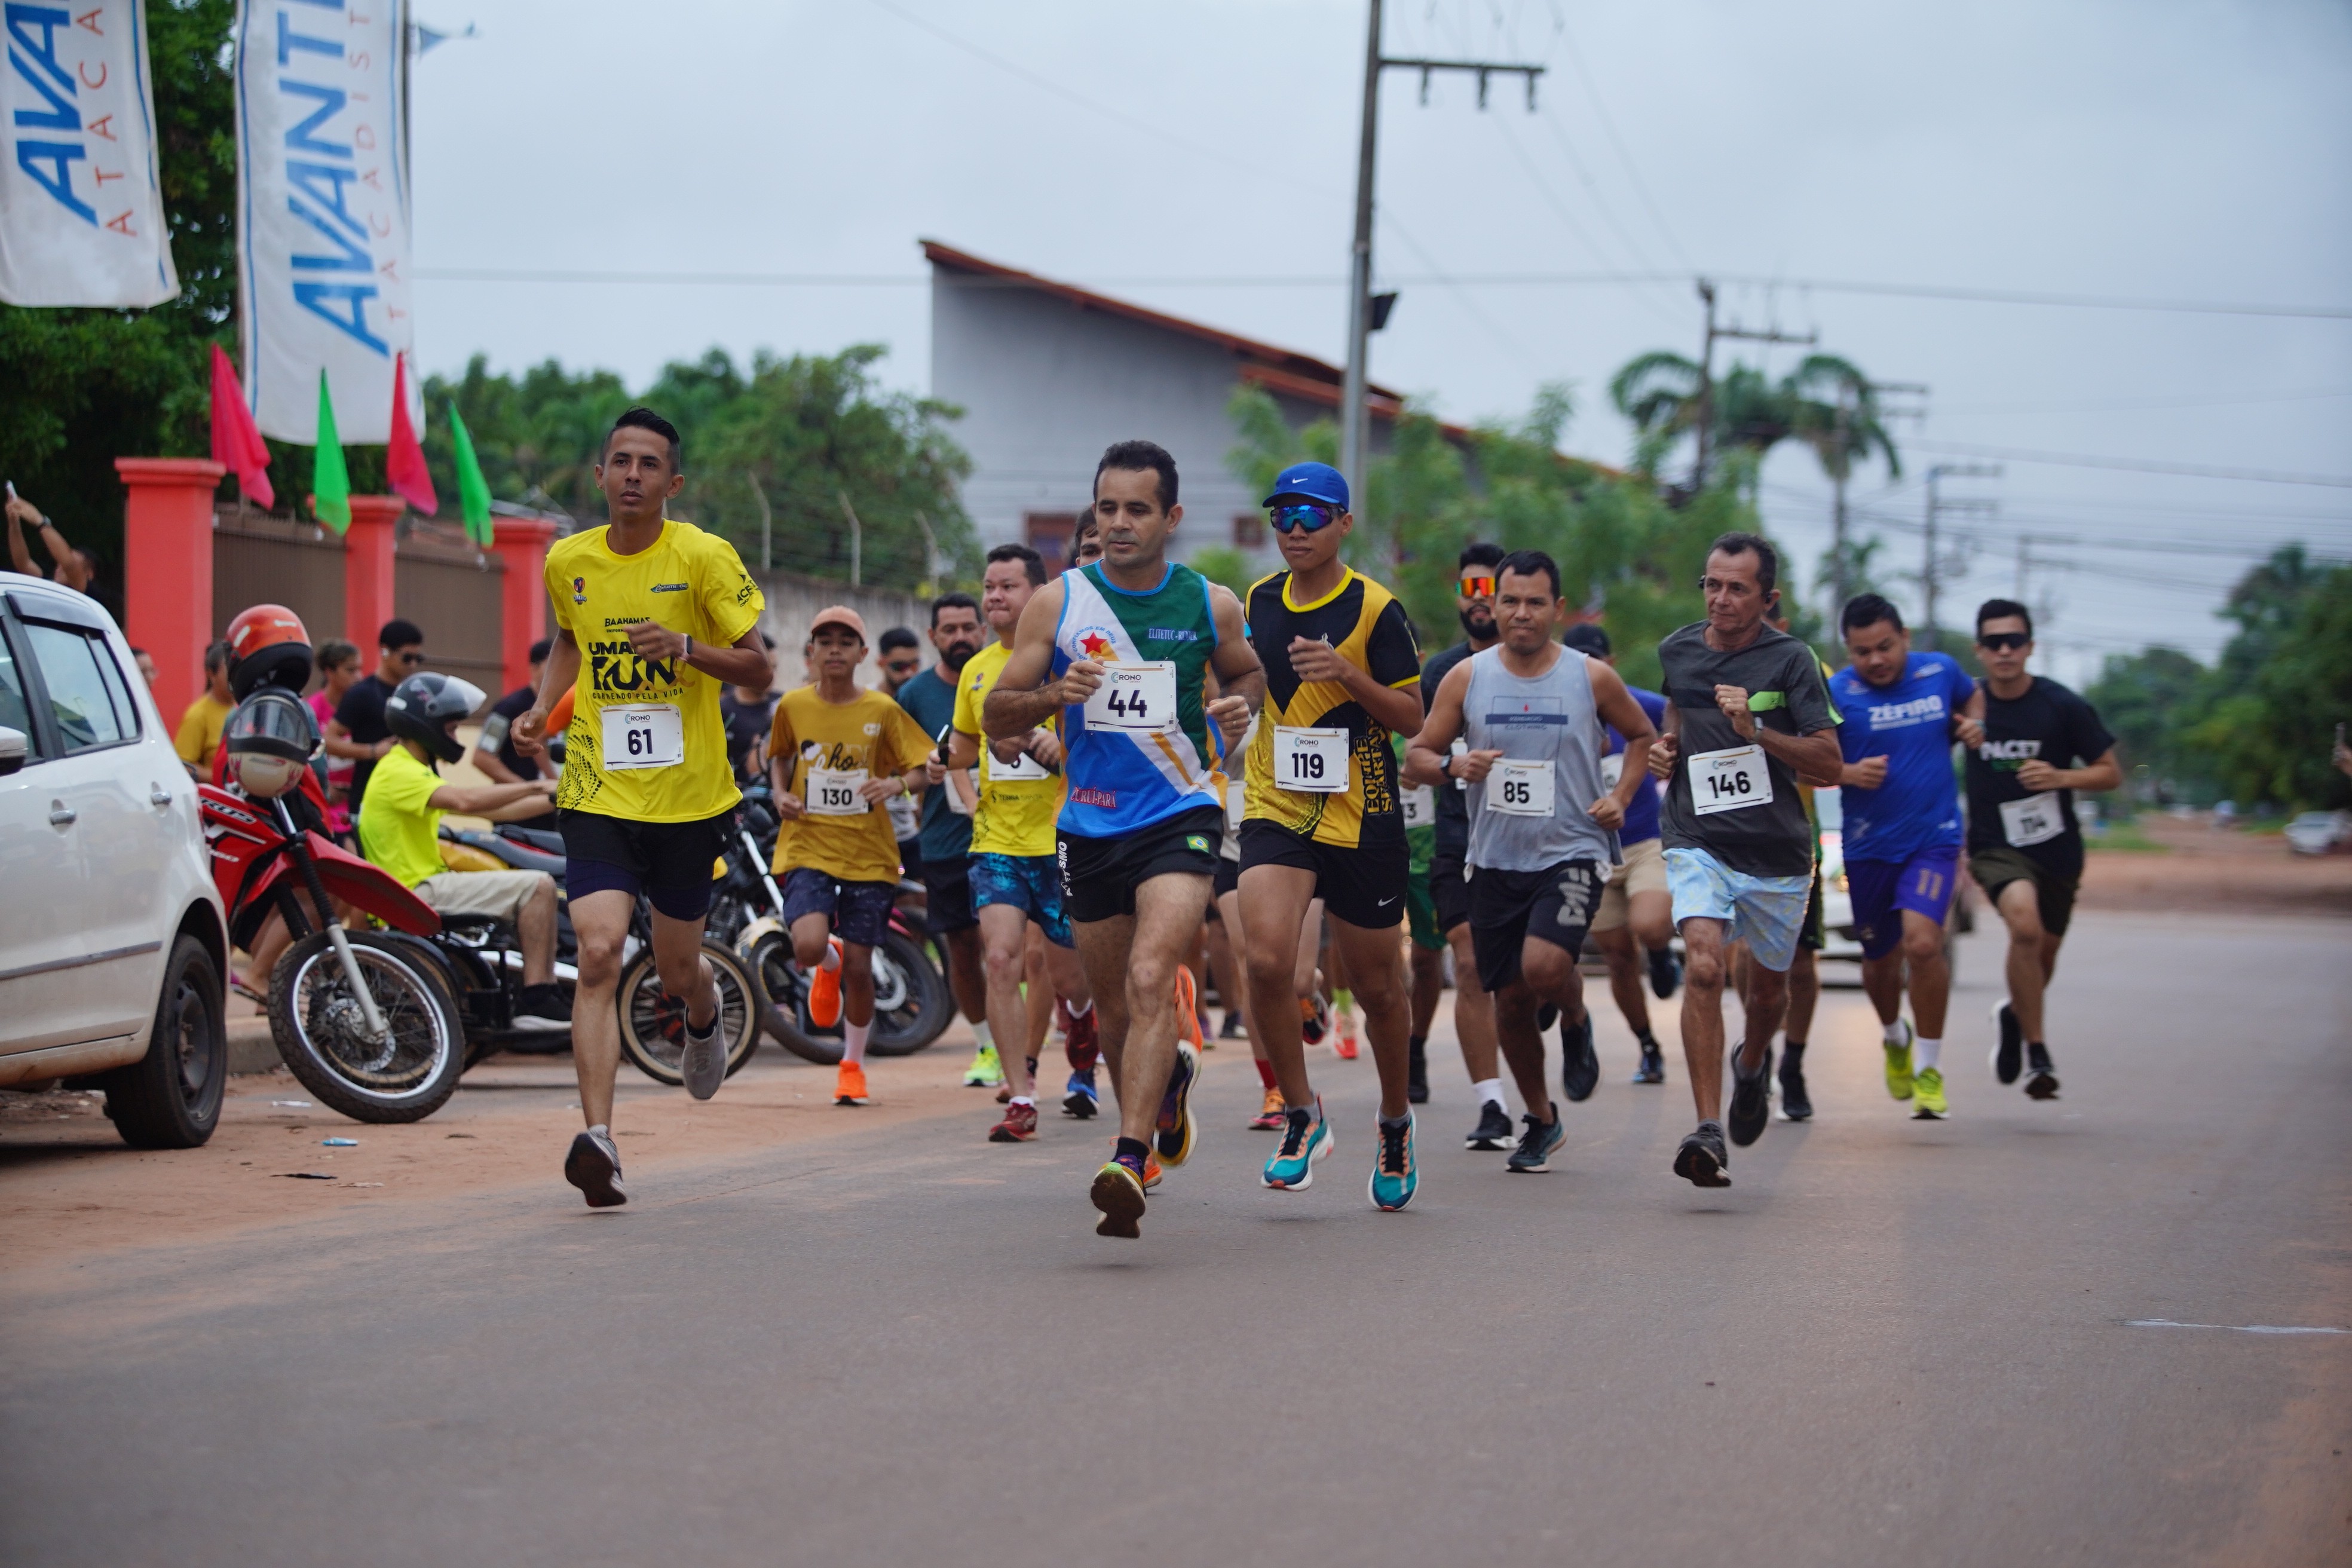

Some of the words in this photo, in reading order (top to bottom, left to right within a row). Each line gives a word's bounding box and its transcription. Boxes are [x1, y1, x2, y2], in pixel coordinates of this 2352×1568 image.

[277, 0, 390, 359] AVANT
[588, 641, 637, 656] UMA
[591, 655, 677, 691] RUN
[663, 687, 684, 698] VIDA
[1107, 689, 1148, 718] 44
[627, 728, 653, 755] 61
[1291, 752, 1324, 779] 119
[821, 788, 853, 806] 130
[1504, 781, 1530, 804] 85
[1707, 771, 1751, 800] 146
